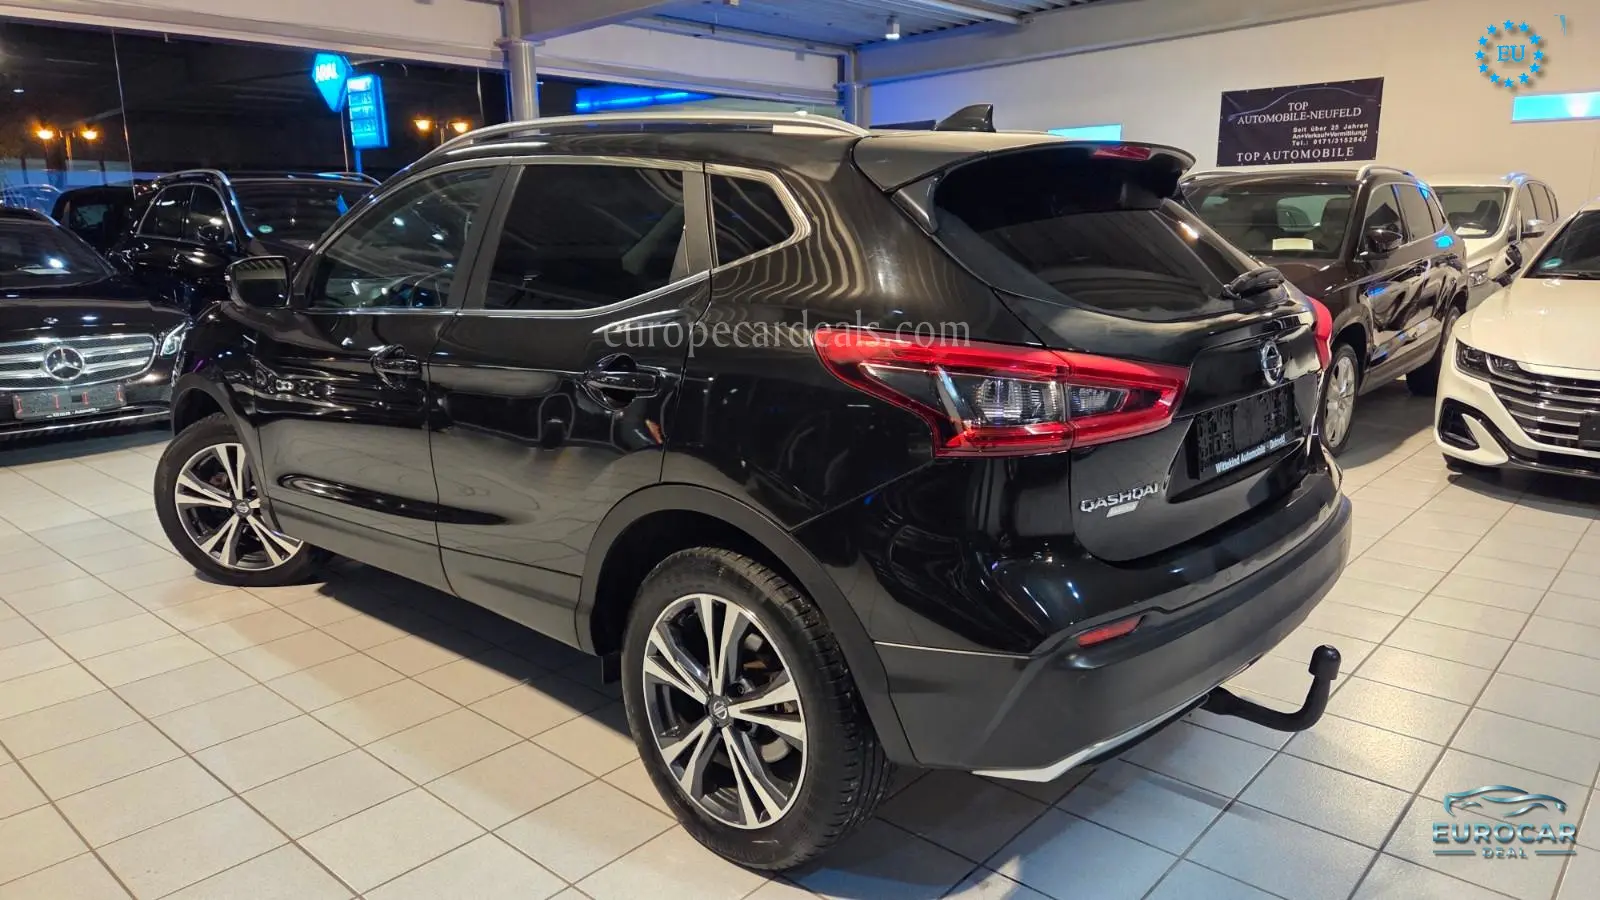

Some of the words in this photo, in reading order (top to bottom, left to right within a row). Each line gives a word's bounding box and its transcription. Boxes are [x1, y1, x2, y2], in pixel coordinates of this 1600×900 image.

[1288, 101, 1309, 112] TOP
[1237, 107, 1362, 125] AUTOMOBILE-NEUFELD
[1236, 151, 1260, 162] TOP
[1263, 147, 1355, 161] AUTOMOBILE
[1080, 482, 1159, 512] QASHQAI
